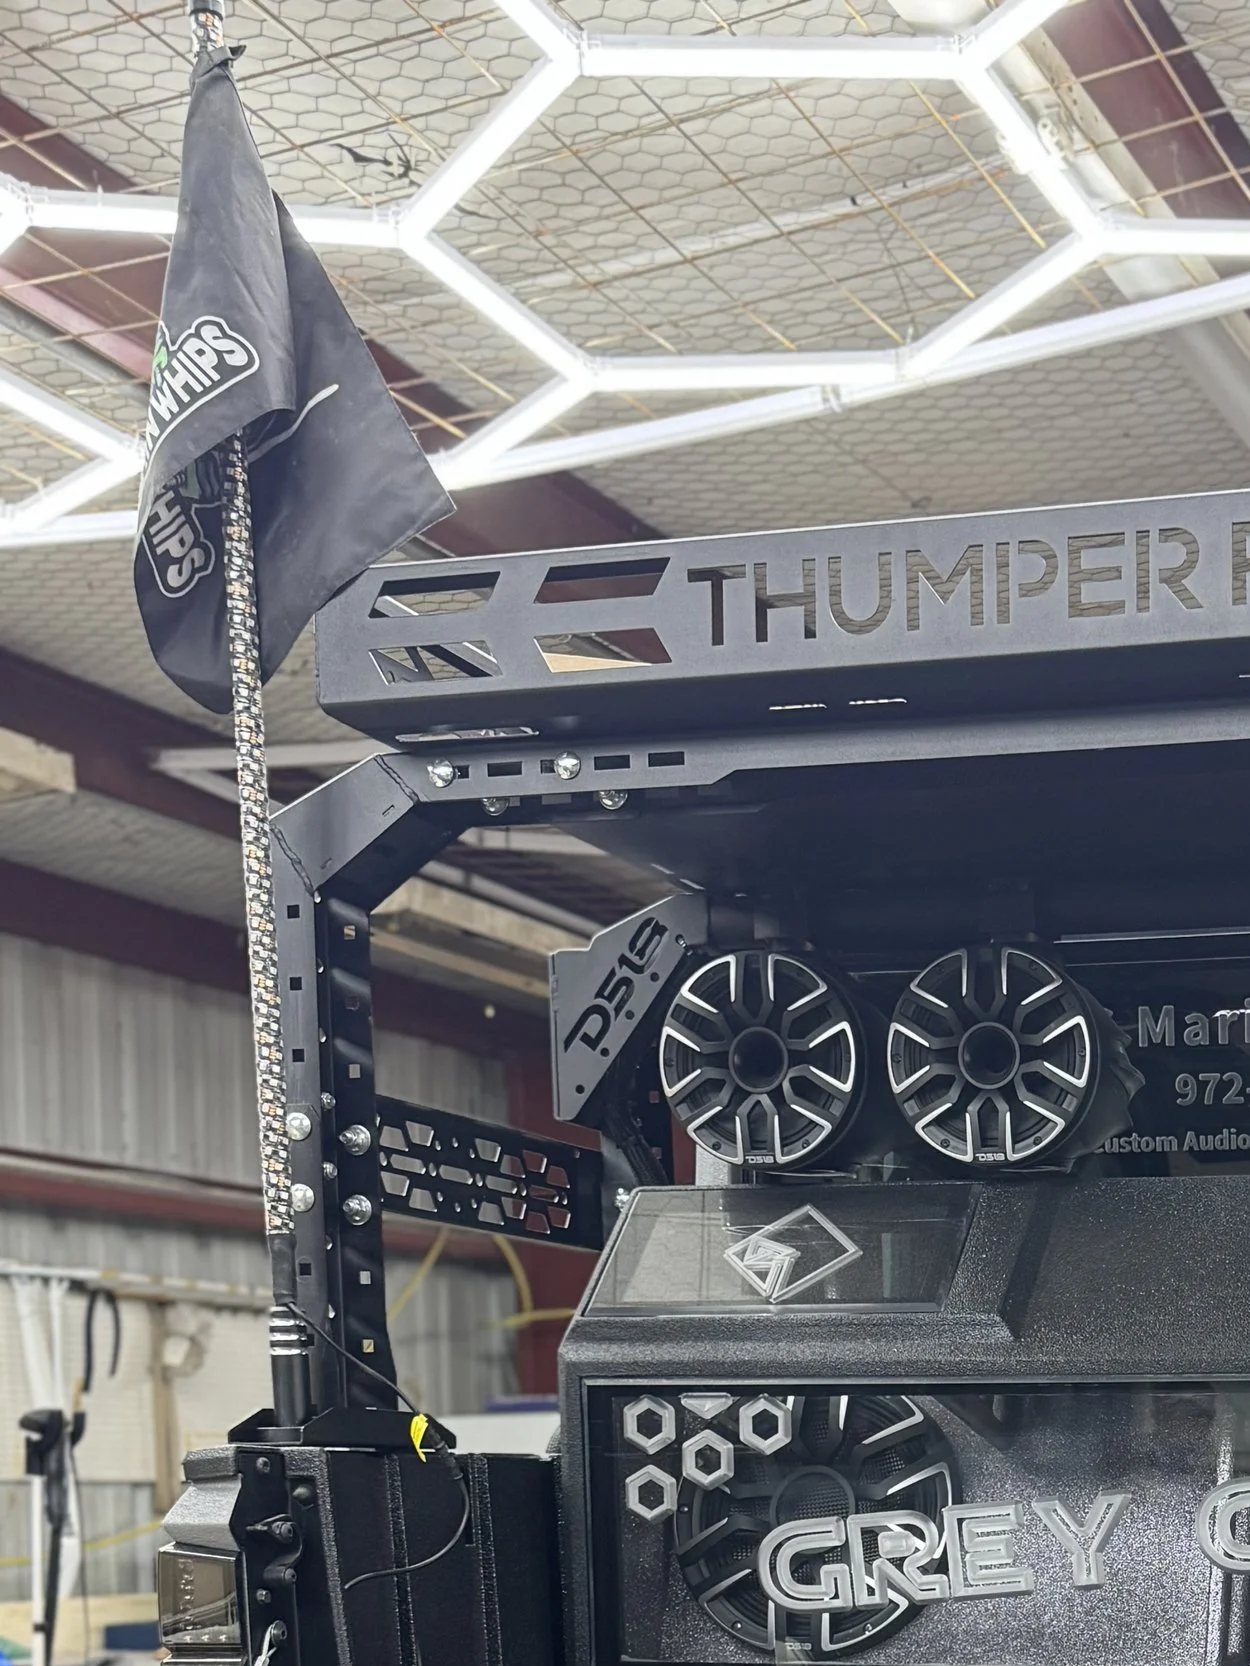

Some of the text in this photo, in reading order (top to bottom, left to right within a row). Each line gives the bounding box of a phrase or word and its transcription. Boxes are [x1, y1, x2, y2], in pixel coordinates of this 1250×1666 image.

[148, 324, 249, 422] WHIPS
[149, 489, 206, 588] HIPS
[687, 527, 1203, 646] THUMPER
[1093, 1132, 1178, 1154] ustom
[758, 1489, 1132, 1613] GREY
